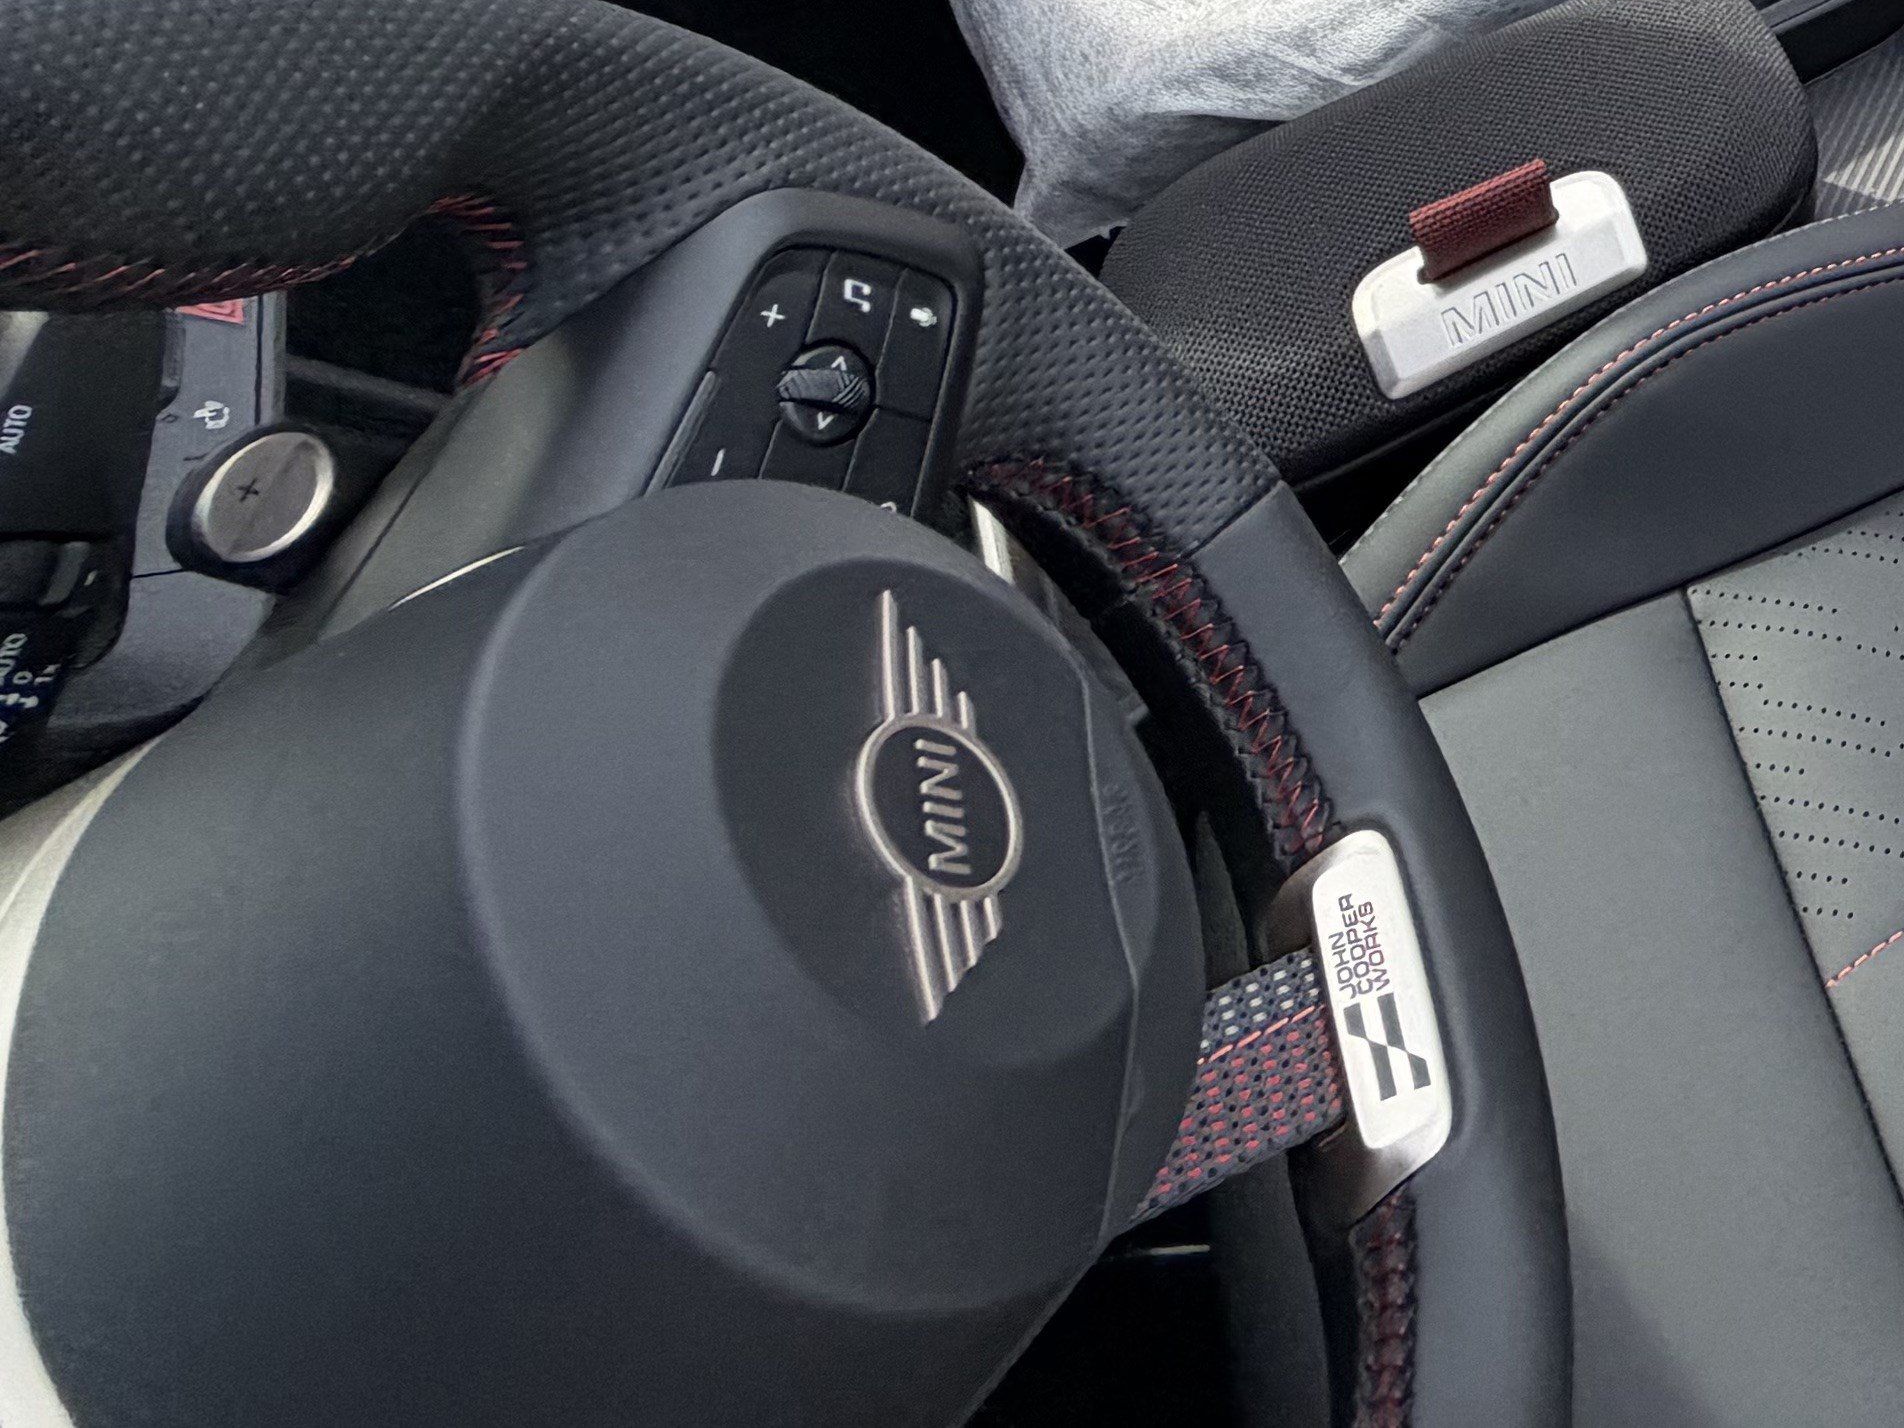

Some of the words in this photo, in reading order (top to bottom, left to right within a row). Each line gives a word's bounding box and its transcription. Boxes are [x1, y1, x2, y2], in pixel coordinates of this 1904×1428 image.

[1441, 253, 1577, 346] MINI
[0, 405, 33, 454] AUTO
[914, 738, 971, 874] MINI
[1328, 932, 1356, 998] JOHN
[1338, 893, 1372, 994] COOPER
[1359, 901, 1389, 990] WORKS
